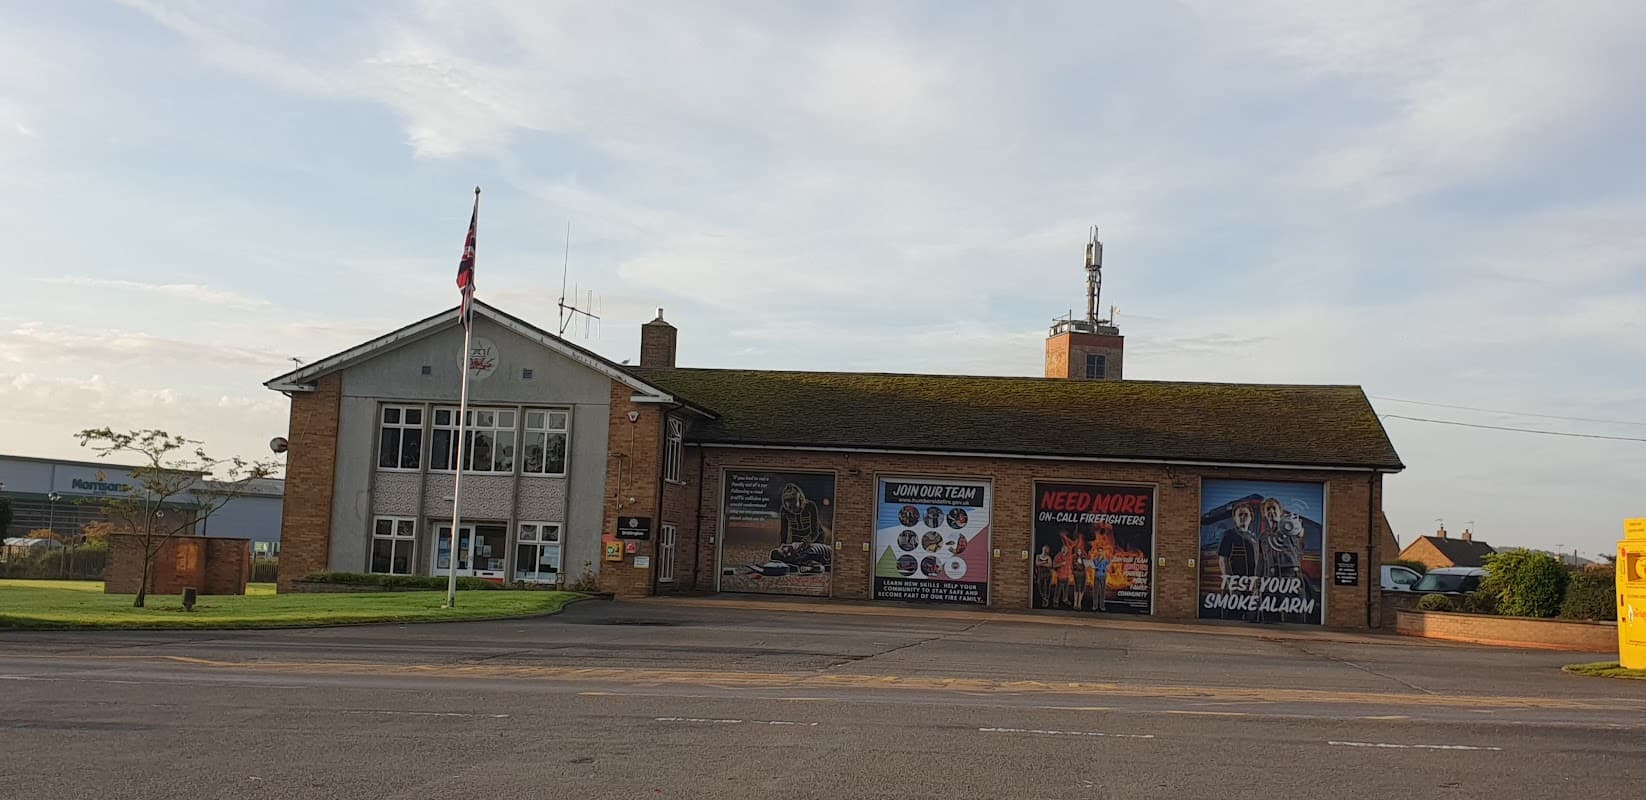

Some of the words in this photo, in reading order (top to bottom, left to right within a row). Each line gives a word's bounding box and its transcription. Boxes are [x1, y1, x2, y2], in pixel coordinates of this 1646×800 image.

[892, 484, 920, 496] JOIN
[920, 485, 943, 498] OUR
[945, 486, 976, 499] TEAM
[1040, 491, 1091, 512] NEED
[1093, 494, 1148, 513] MORE
[1039, 512, 1078, 522] ON-CALL
[1080, 513, 1145, 526] FIREFIGHTERS
[1220, 574, 1258, 591] TEST
[1259, 577, 1302, 594] YOUR
[1204, 593, 1260, 610] SMOKE
[1259, 596, 1315, 614] ALARM
